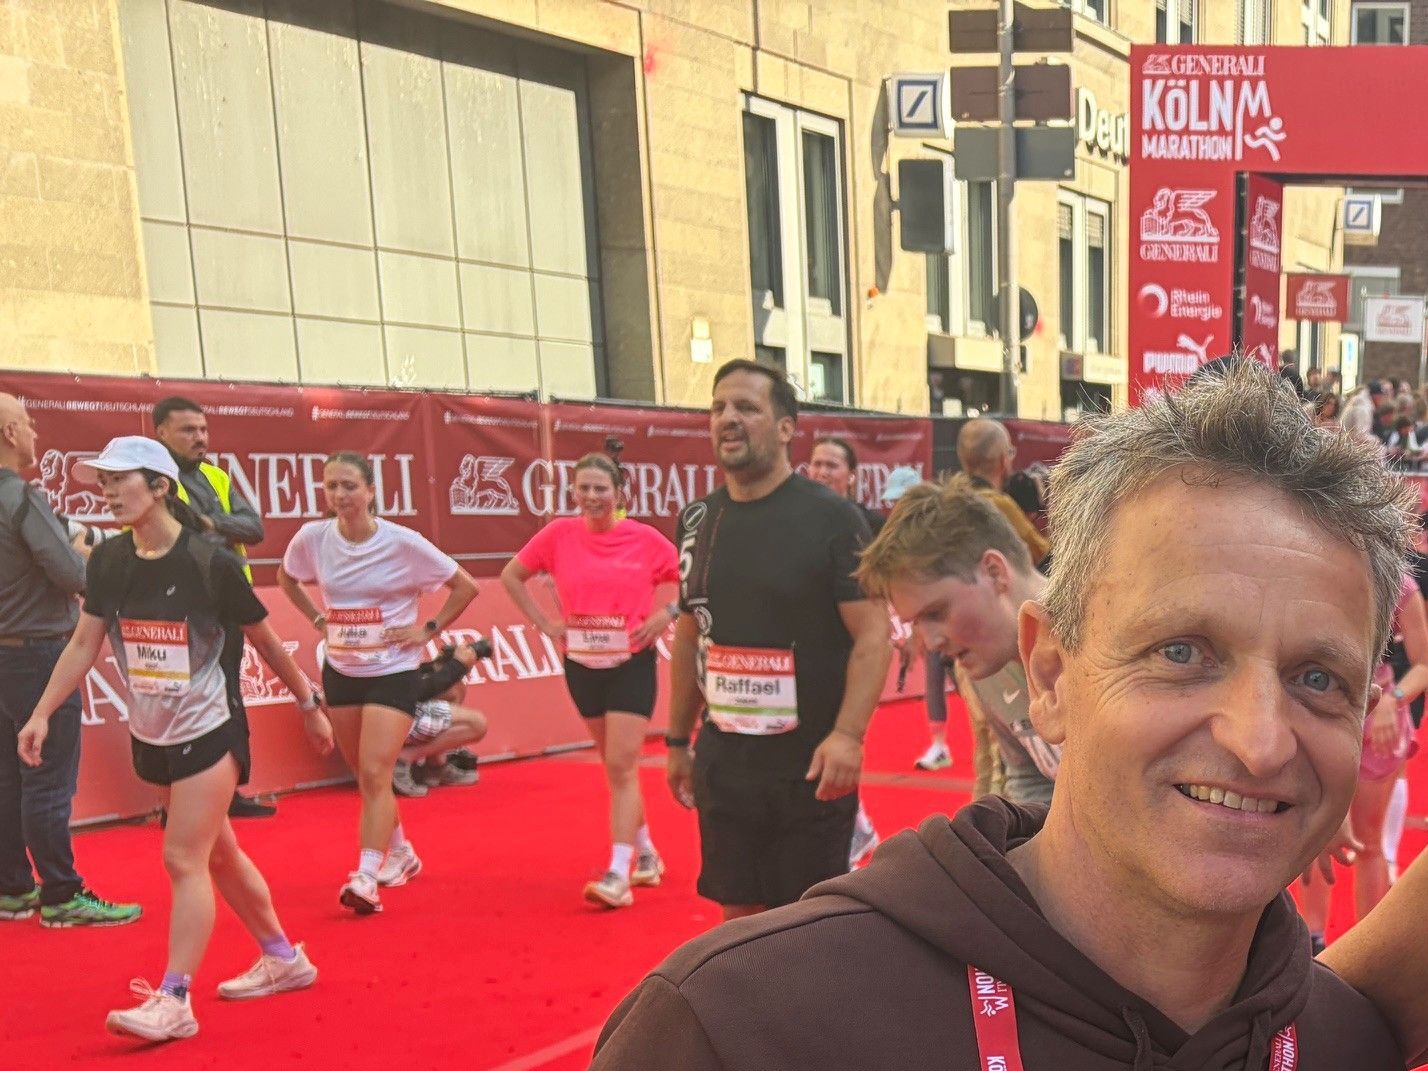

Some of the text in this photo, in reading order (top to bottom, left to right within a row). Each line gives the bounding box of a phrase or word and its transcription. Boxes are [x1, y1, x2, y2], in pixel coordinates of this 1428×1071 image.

[1171, 54, 1266, 75] GENERALI
[1142, 78, 1234, 132] KÖLN
[1141, 134, 1233, 161] MARATHON
[1140, 243, 1219, 263] GENERALI
[1170, 304, 1223, 321] Energie
[714, 676, 781, 695] Raffael
